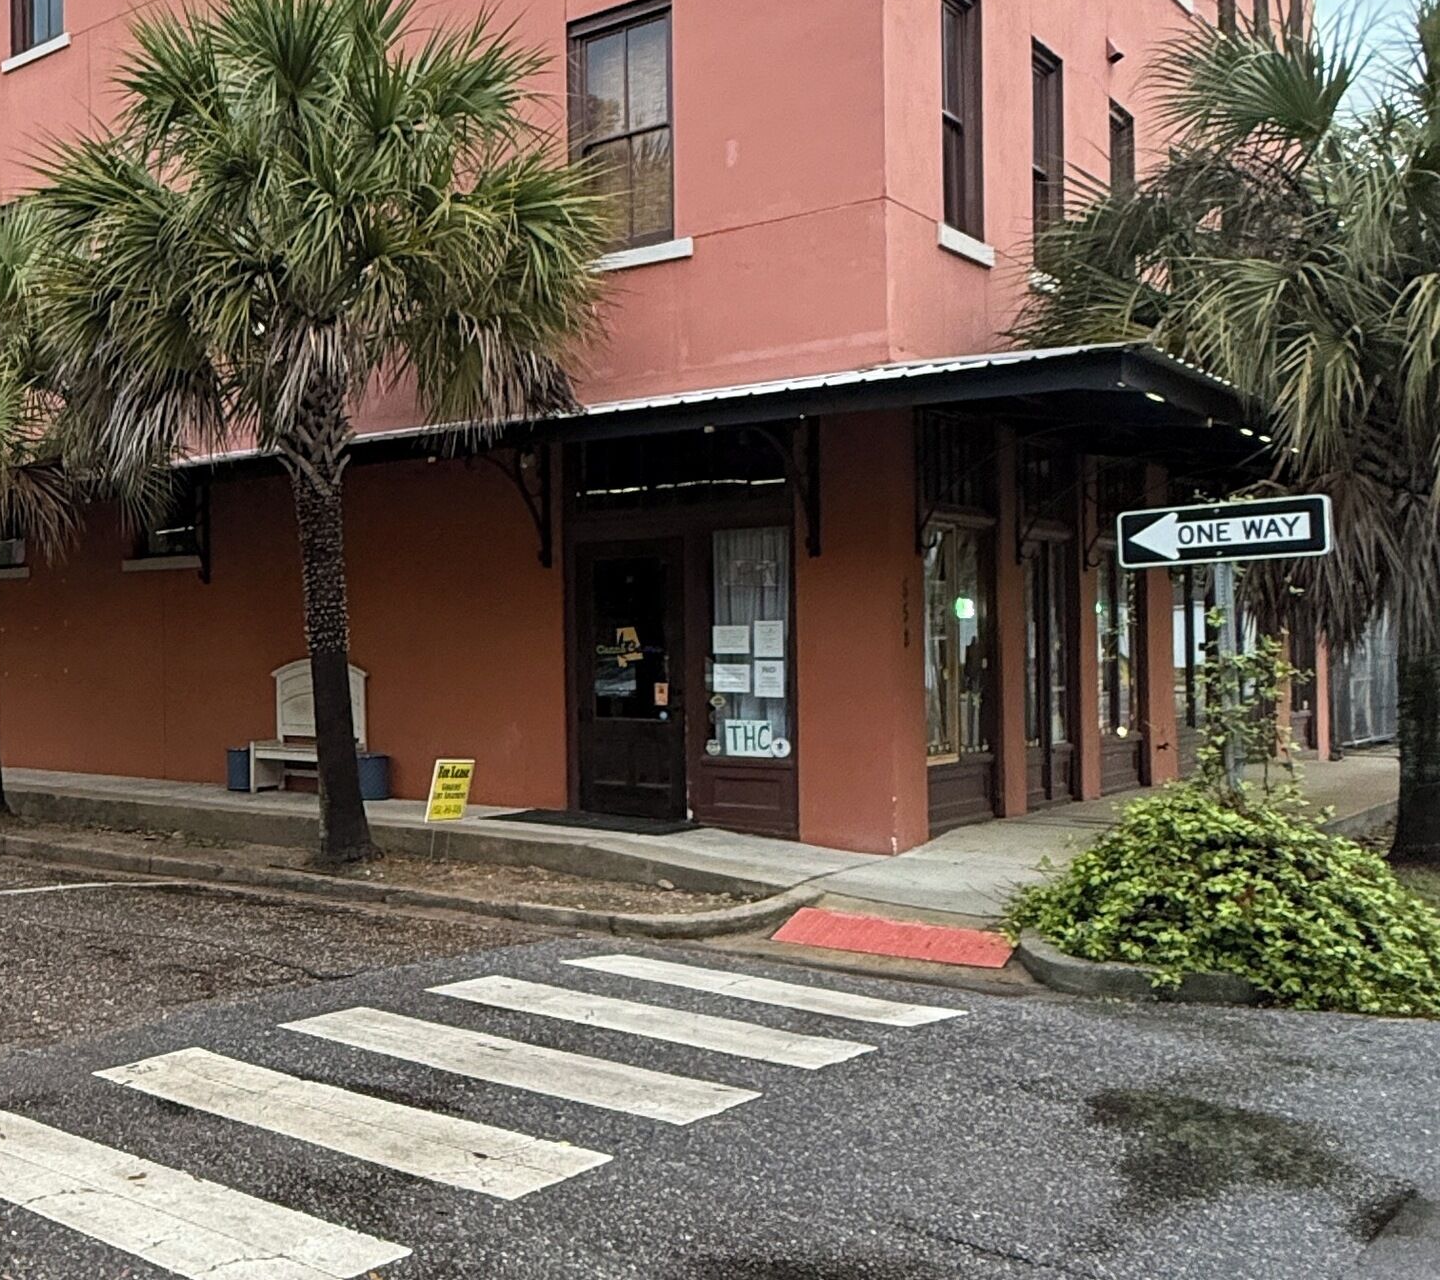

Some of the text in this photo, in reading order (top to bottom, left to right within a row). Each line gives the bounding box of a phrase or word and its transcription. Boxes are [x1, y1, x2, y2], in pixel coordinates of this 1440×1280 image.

[1177, 516, 1300, 545] ONE WAY
[727, 725, 770, 751] THC
